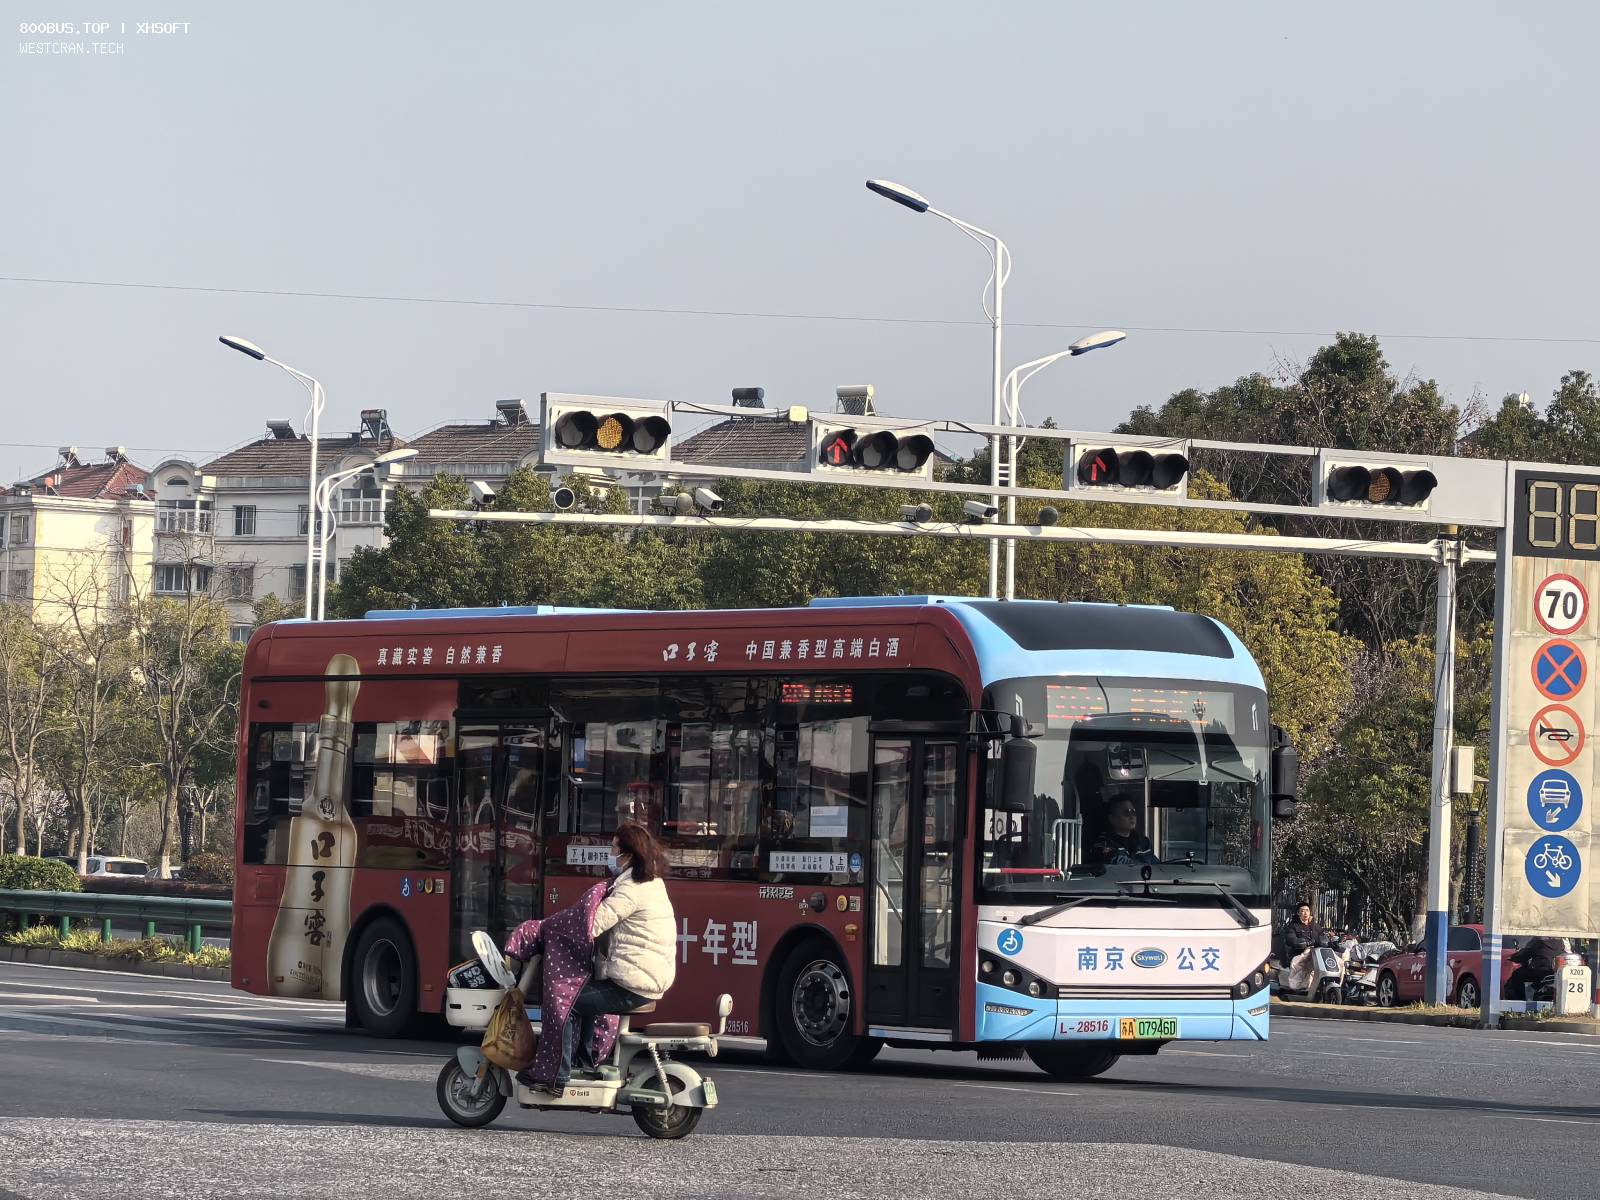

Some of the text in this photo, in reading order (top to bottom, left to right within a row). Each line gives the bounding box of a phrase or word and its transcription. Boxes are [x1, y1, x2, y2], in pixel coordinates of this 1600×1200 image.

[1545, 590, 1578, 619] 70
[377, 645, 503, 665] 真藏实窖 自然兼香
[745, 637, 900, 661] 中国兼香型高端白酒
[676, 917, 758, 966] 十年型
[1077, 946, 1220, 971] 南京 公交
[1568, 982, 1584, 993] 28
[1060, 1019, 1109, 1034] L-28516
